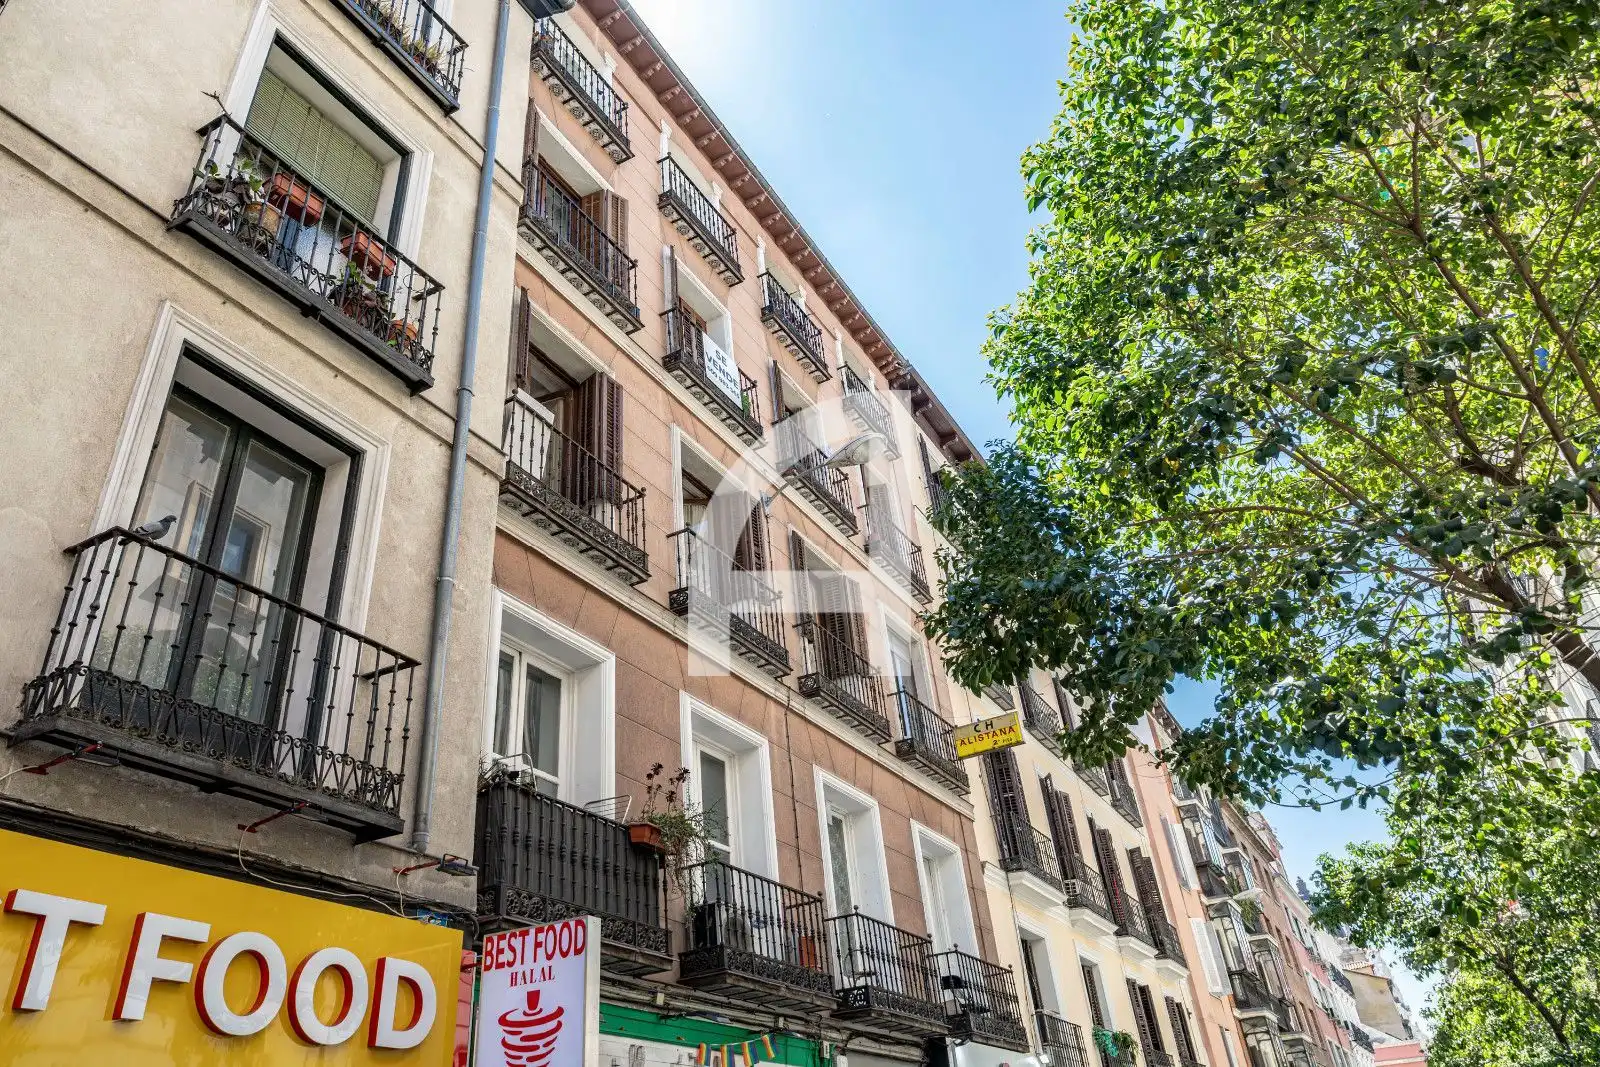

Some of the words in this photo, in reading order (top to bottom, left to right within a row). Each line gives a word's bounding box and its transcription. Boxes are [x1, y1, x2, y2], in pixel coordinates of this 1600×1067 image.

[705, 351, 739, 390] VENDE
[715, 350, 727, 367] SE
[960, 726, 1015, 746] ALISTANA
[484, 929, 530, 971] BEST
[533, 919, 586, 962] FOOD
[0, 889, 107, 1011] T
[112, 912, 437, 1049] FOOD
[510, 966, 555, 987] HALAL
